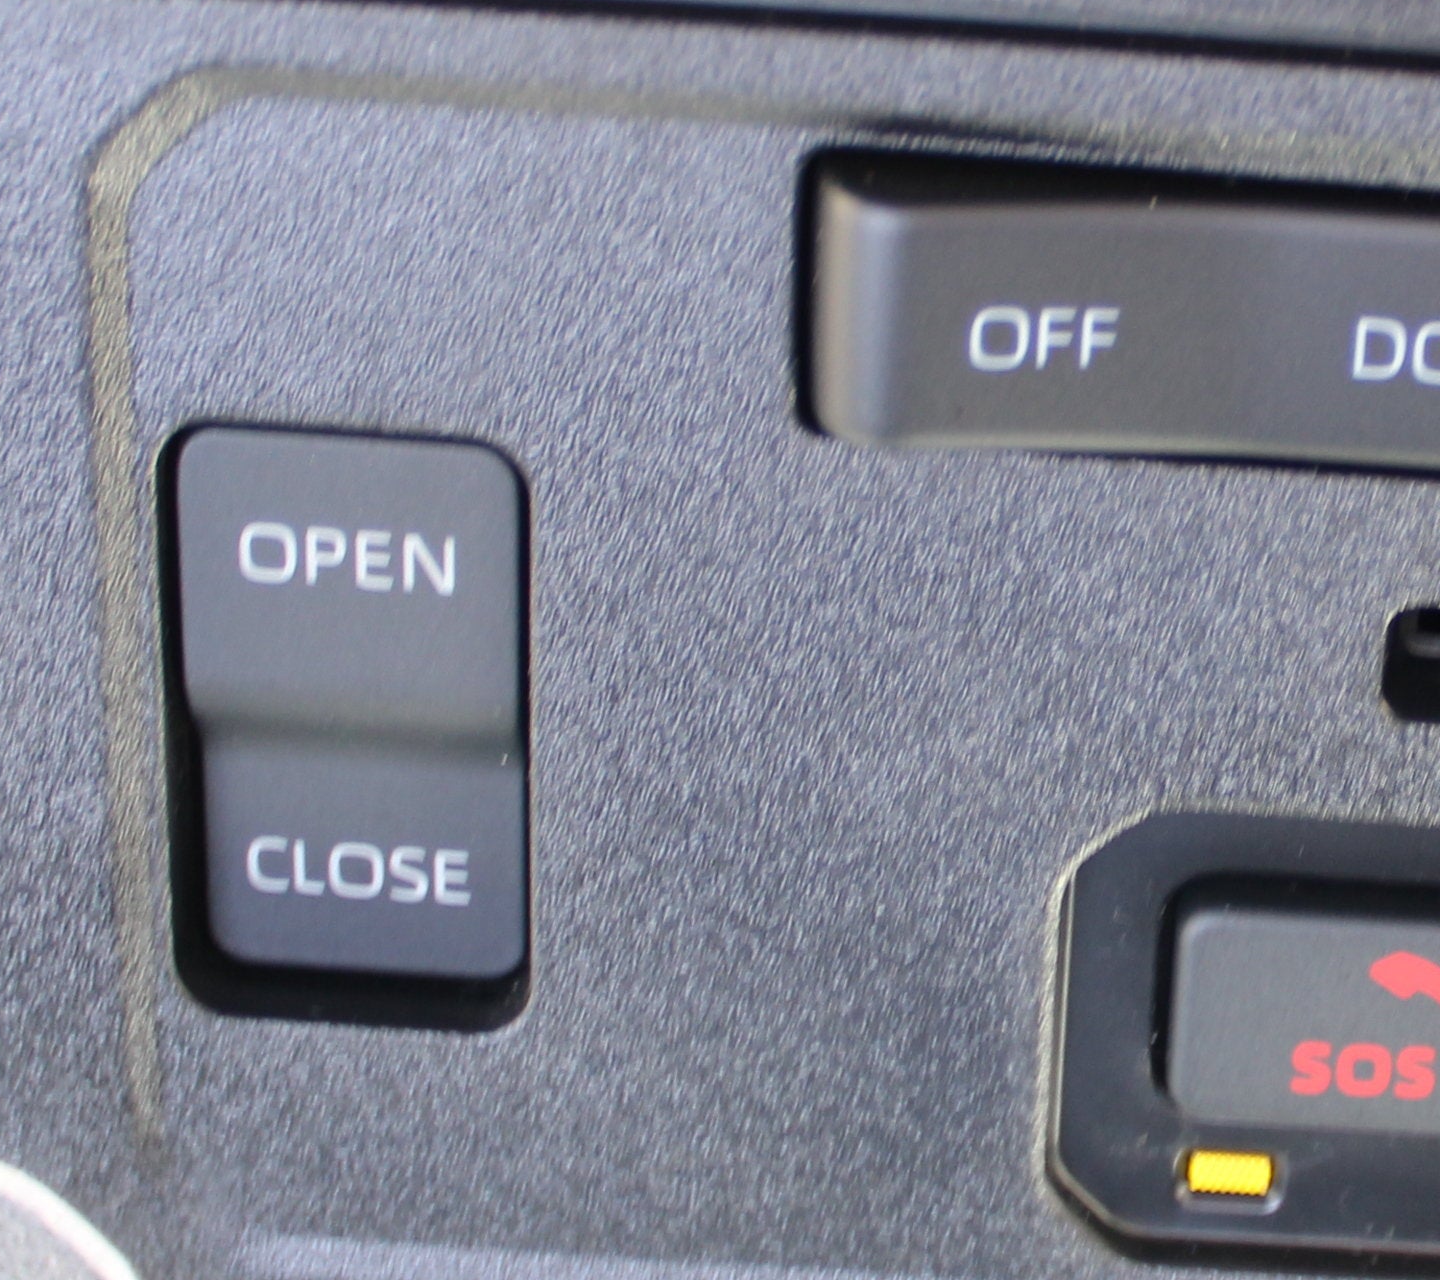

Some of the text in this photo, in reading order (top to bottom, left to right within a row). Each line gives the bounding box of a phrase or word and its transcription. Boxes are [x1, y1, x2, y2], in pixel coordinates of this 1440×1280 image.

[967, 305, 1119, 371] OFF
[236, 521, 457, 596] OPEN
[245, 835, 471, 906] CLOSE
[1288, 1038, 1438, 1103] SOS
